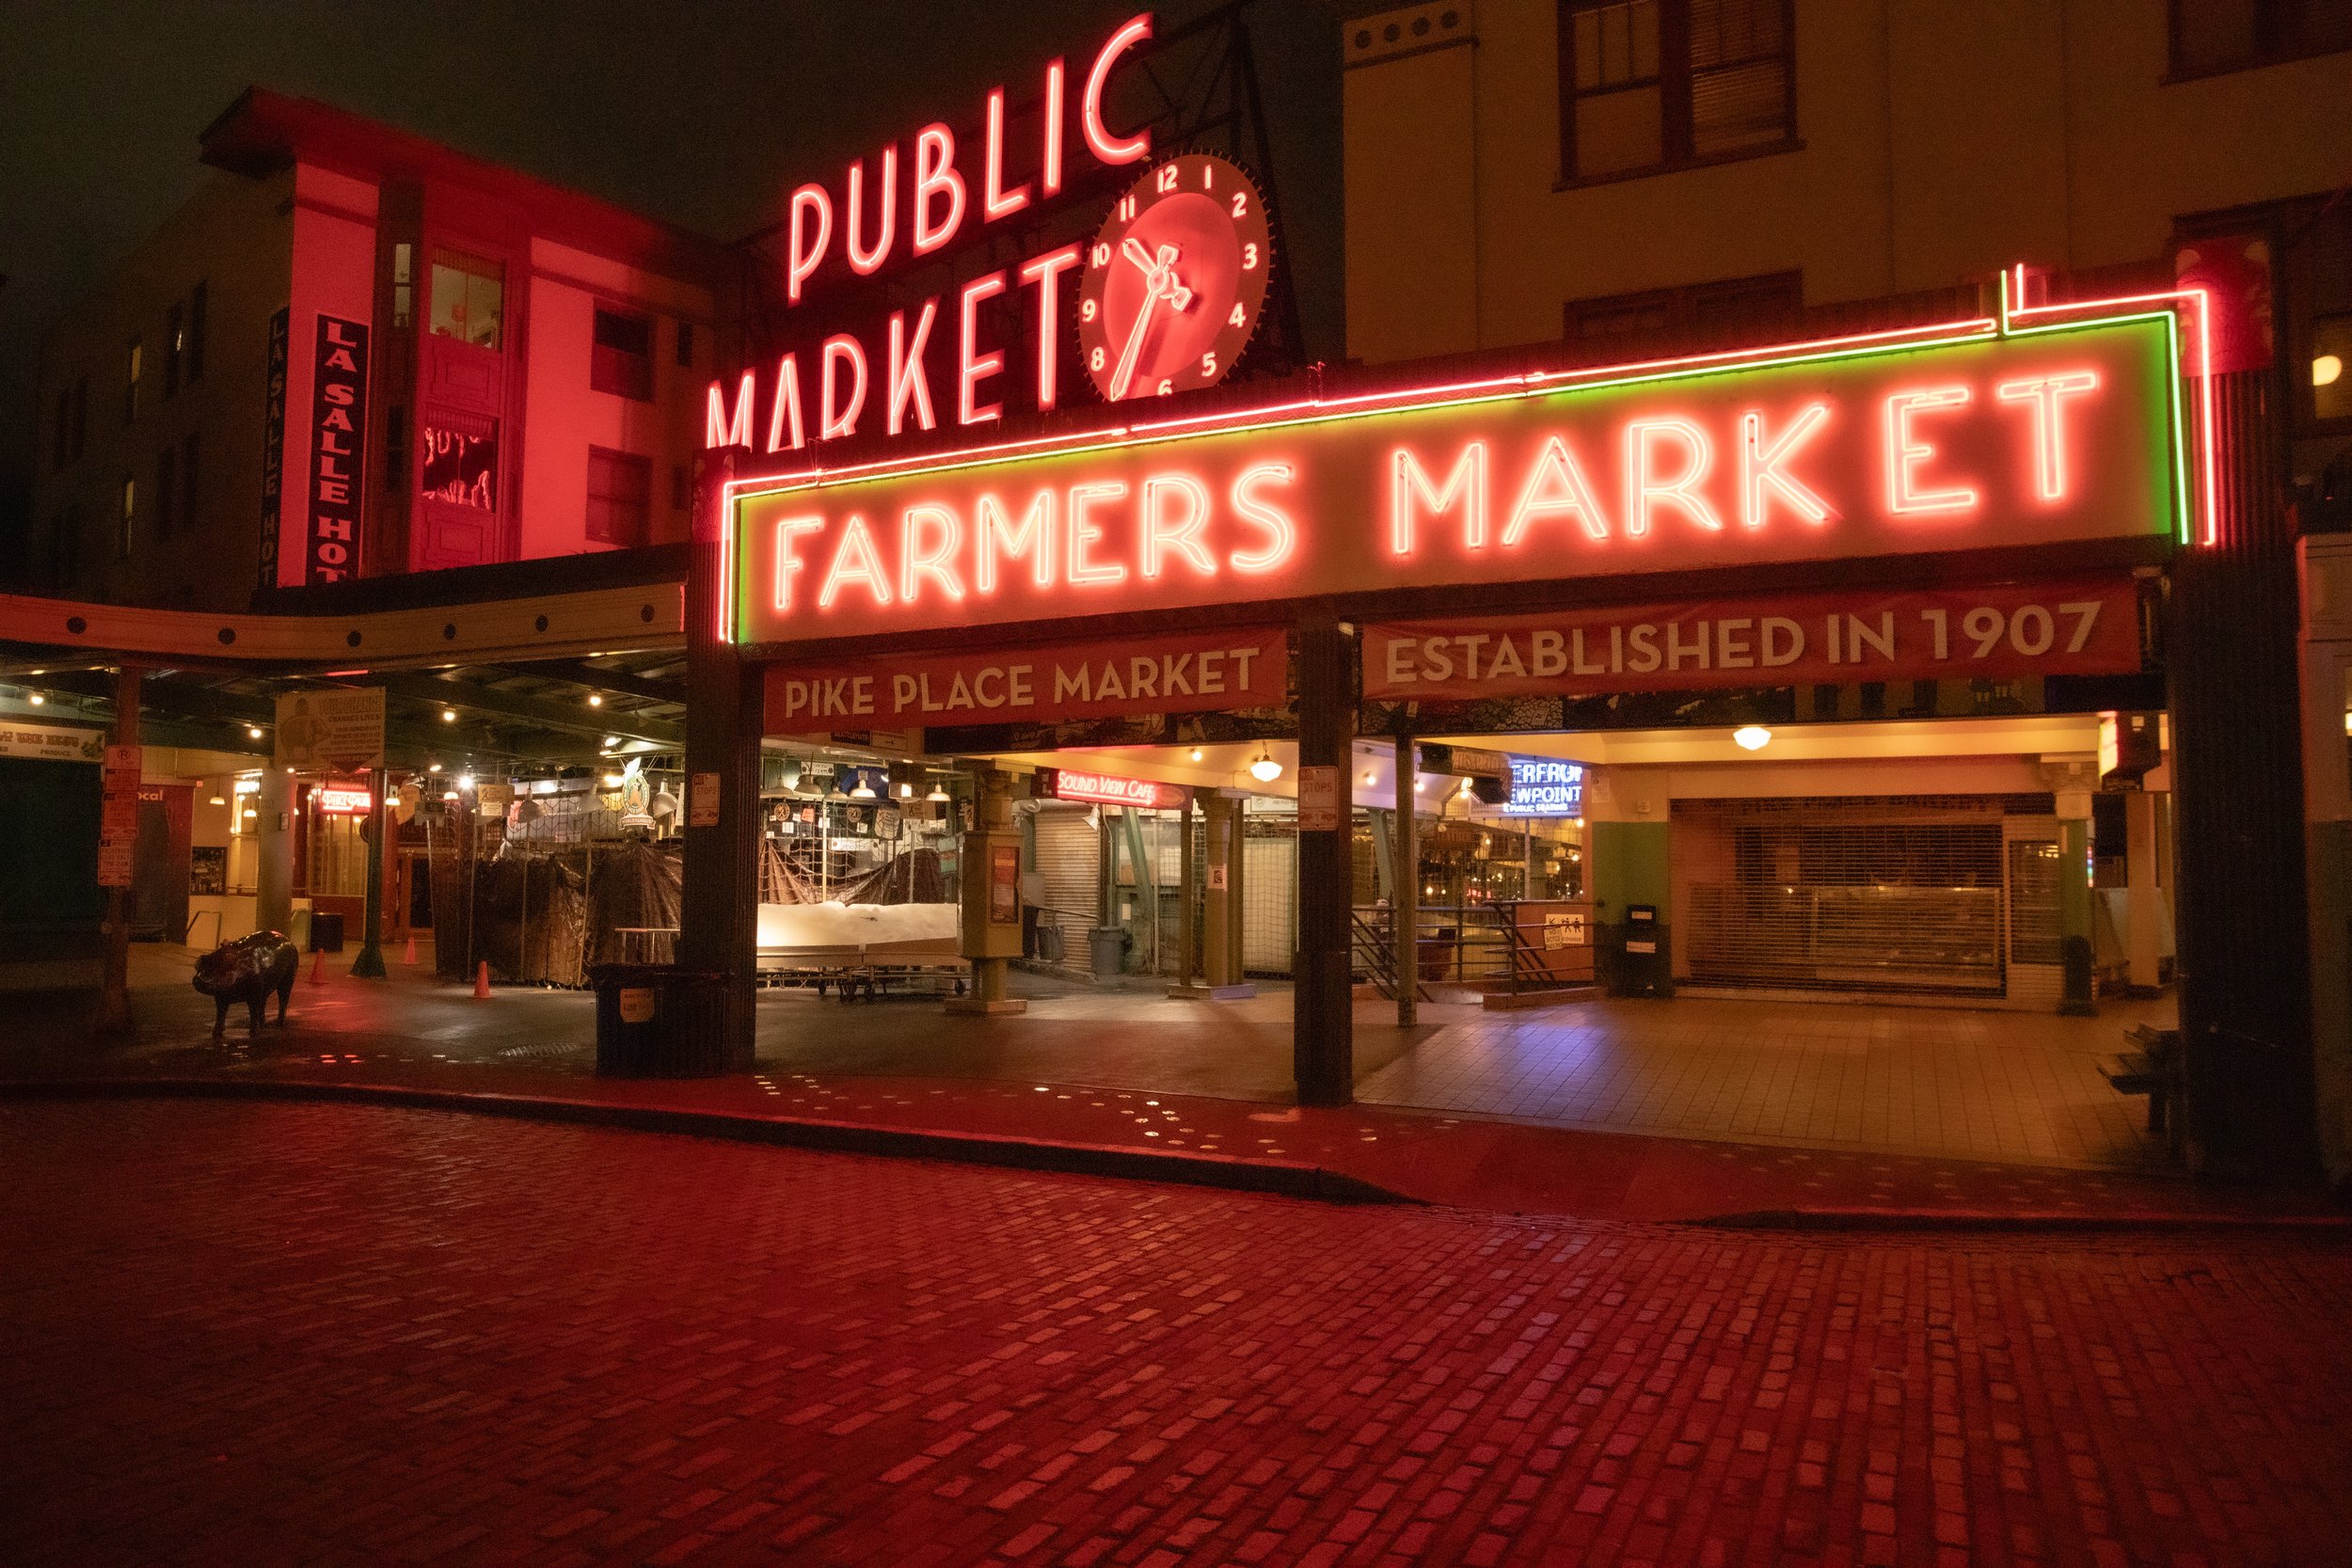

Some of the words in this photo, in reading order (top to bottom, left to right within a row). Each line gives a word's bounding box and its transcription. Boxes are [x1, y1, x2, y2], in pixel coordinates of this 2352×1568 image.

[788, 11, 1153, 307] PUBLIC
[1157, 164, 1178, 194] 12
[1204, 165, 1213, 189] 1
[1232, 192, 1247, 217] 2
[1244, 244, 1258, 270] 3
[1082, 298, 1095, 323] 9
[1229, 302, 1247, 328] 4
[324, 321, 358, 372] LA
[707, 242, 1083, 453] MARKET
[1090, 346, 1104, 372] 8
[1202, 353, 1216, 377] 5
[318, 383, 355, 505] SALLE
[773, 462, 1298, 612] FARMERS
[1391, 371, 2100, 555] MARKET
[1384, 616, 1805, 685] ESTABLISHED
[1826, 613, 1897, 664] IN
[1919, 600, 2104, 660] 1907
[785, 676, 875, 719] PIKE
[893, 664, 1035, 713] PLACE
[1054, 647, 1261, 704] MARKET
[1057, 770, 1097, 793] SOUND
[1098, 775, 1126, 795] VIEW
[1128, 781, 1154, 800] CAFE
[1510, 804, 1534, 813] PUBLIC
[1535, 803, 1567, 812] SEATING
